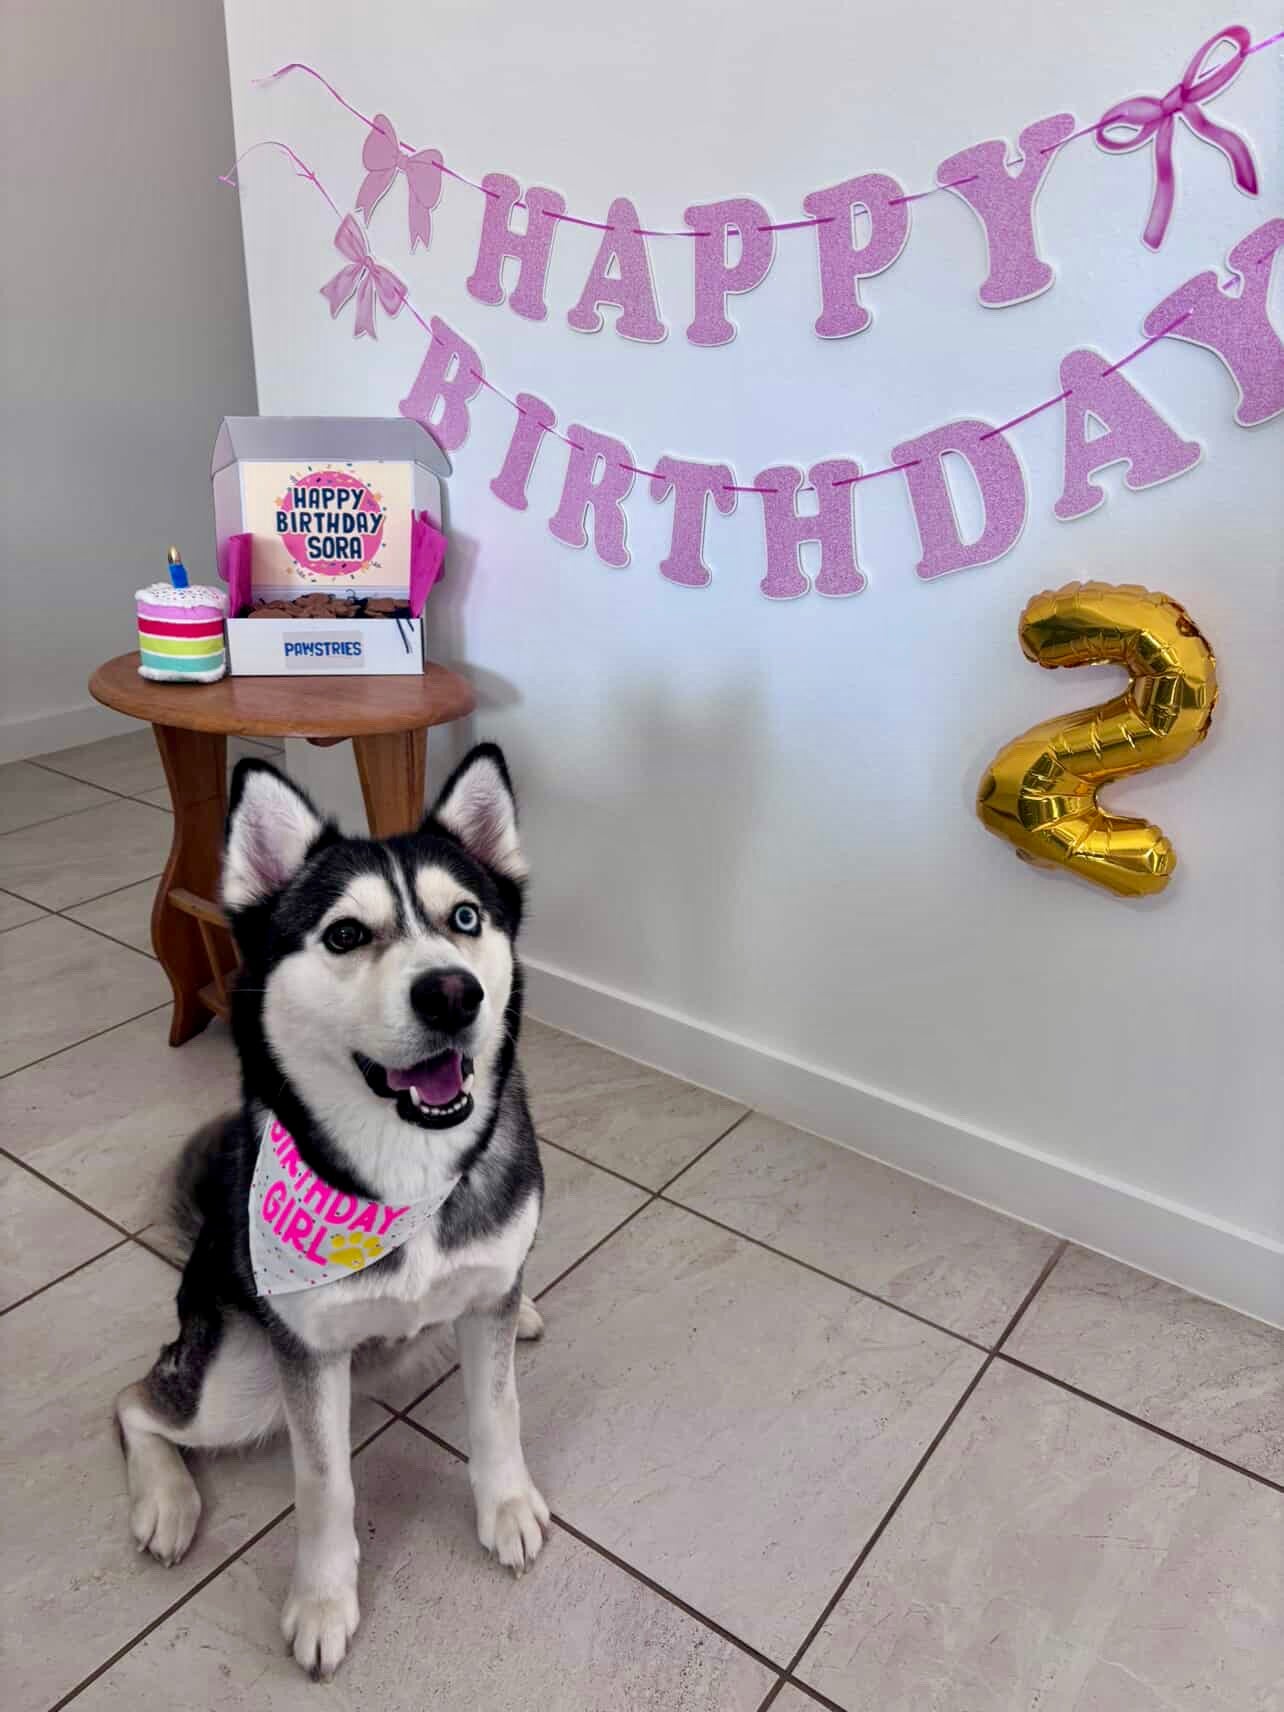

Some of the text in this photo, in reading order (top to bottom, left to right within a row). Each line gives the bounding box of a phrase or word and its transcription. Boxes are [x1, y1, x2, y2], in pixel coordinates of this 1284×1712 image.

[466, 113, 1076, 346] HAPPY
[398, 217, 1284, 599] BIRTHDAY
[276, 511, 383, 534] BIRTHDAY
[293, 487, 364, 510] HAPPY
[307, 536, 362, 559] SORA
[284, 641, 362, 656] PAWSTRIES
[976, 580, 1218, 897] 2
[262, 1180, 328, 1266] GIRL
